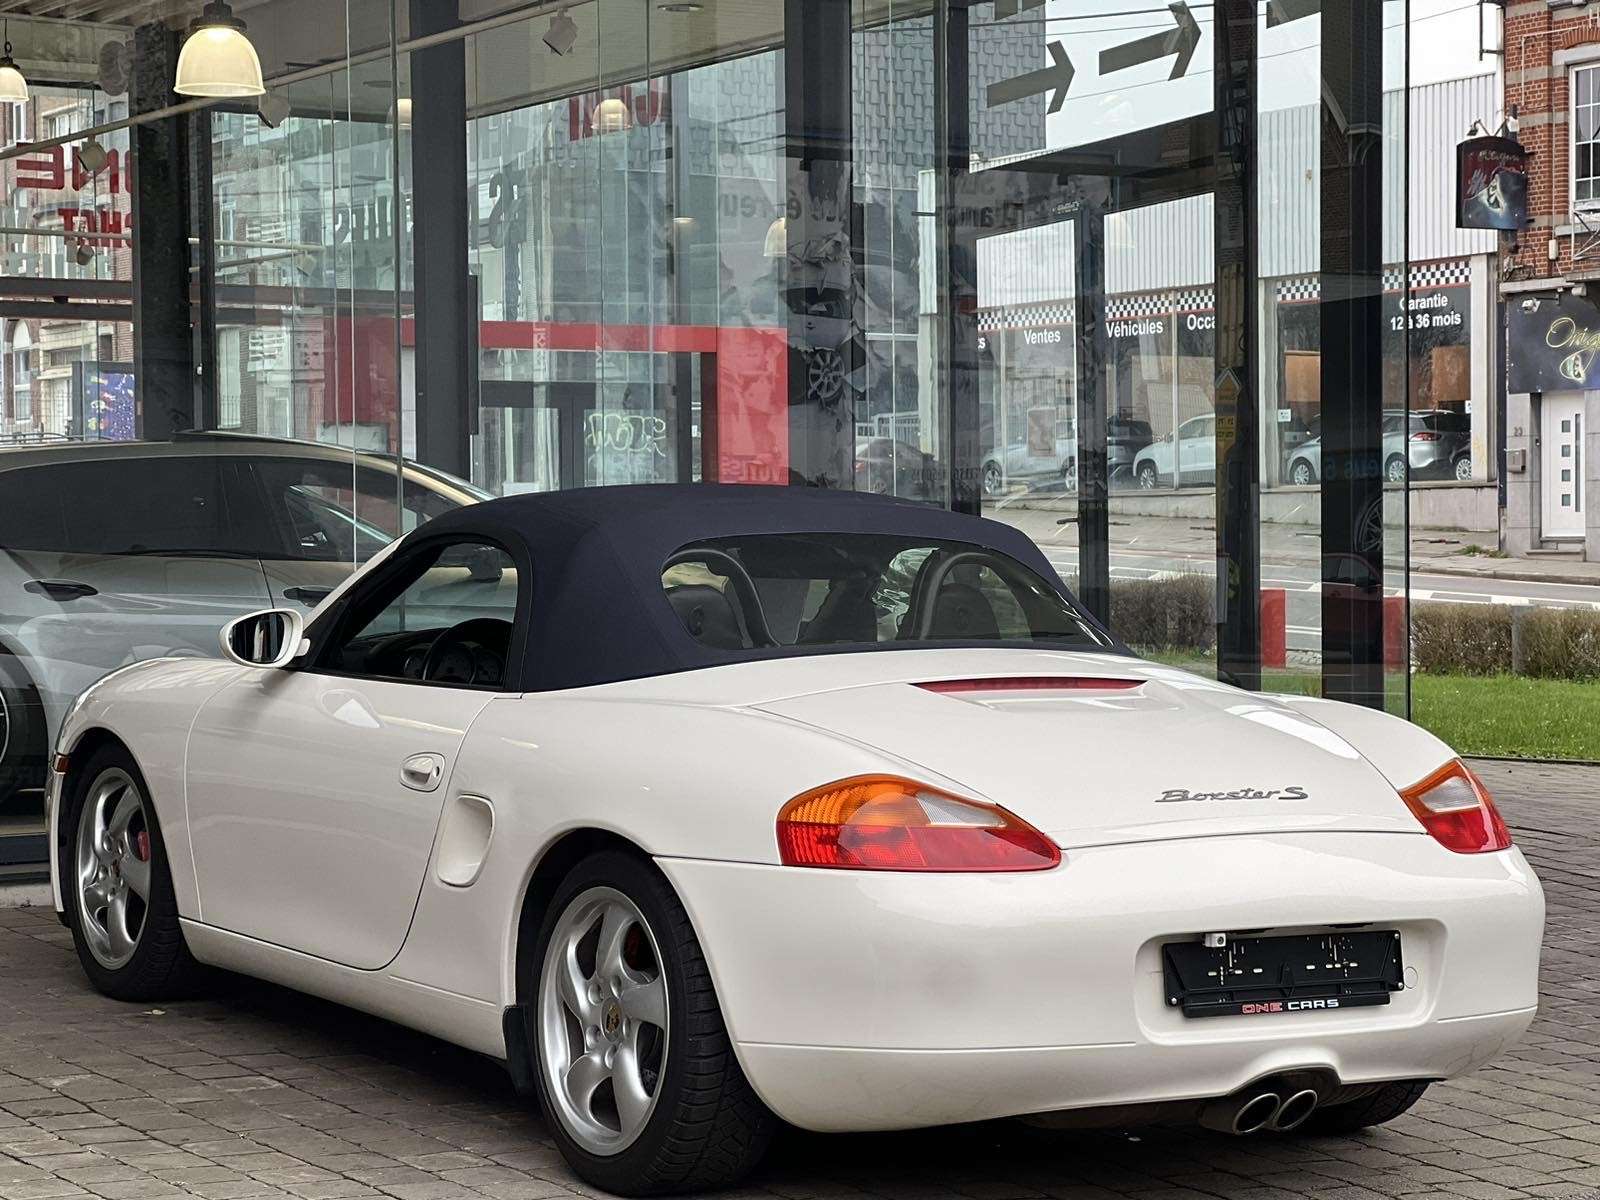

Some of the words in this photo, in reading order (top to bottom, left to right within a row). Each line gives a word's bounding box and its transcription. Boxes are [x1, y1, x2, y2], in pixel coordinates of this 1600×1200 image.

[1105, 319, 1163, 338] Véhicules
[1390, 316, 1404, 331] 12
[1416, 313, 1430, 329] 36
[1432, 311, 1462, 327] mois
[1023, 328, 1061, 345] Ventes
[1155, 788, 1280, 802] Boxster
[1278, 786, 1309, 800] S
[1241, 1002, 1283, 1014] ONE
[1287, 998, 1340, 1011] CARS
